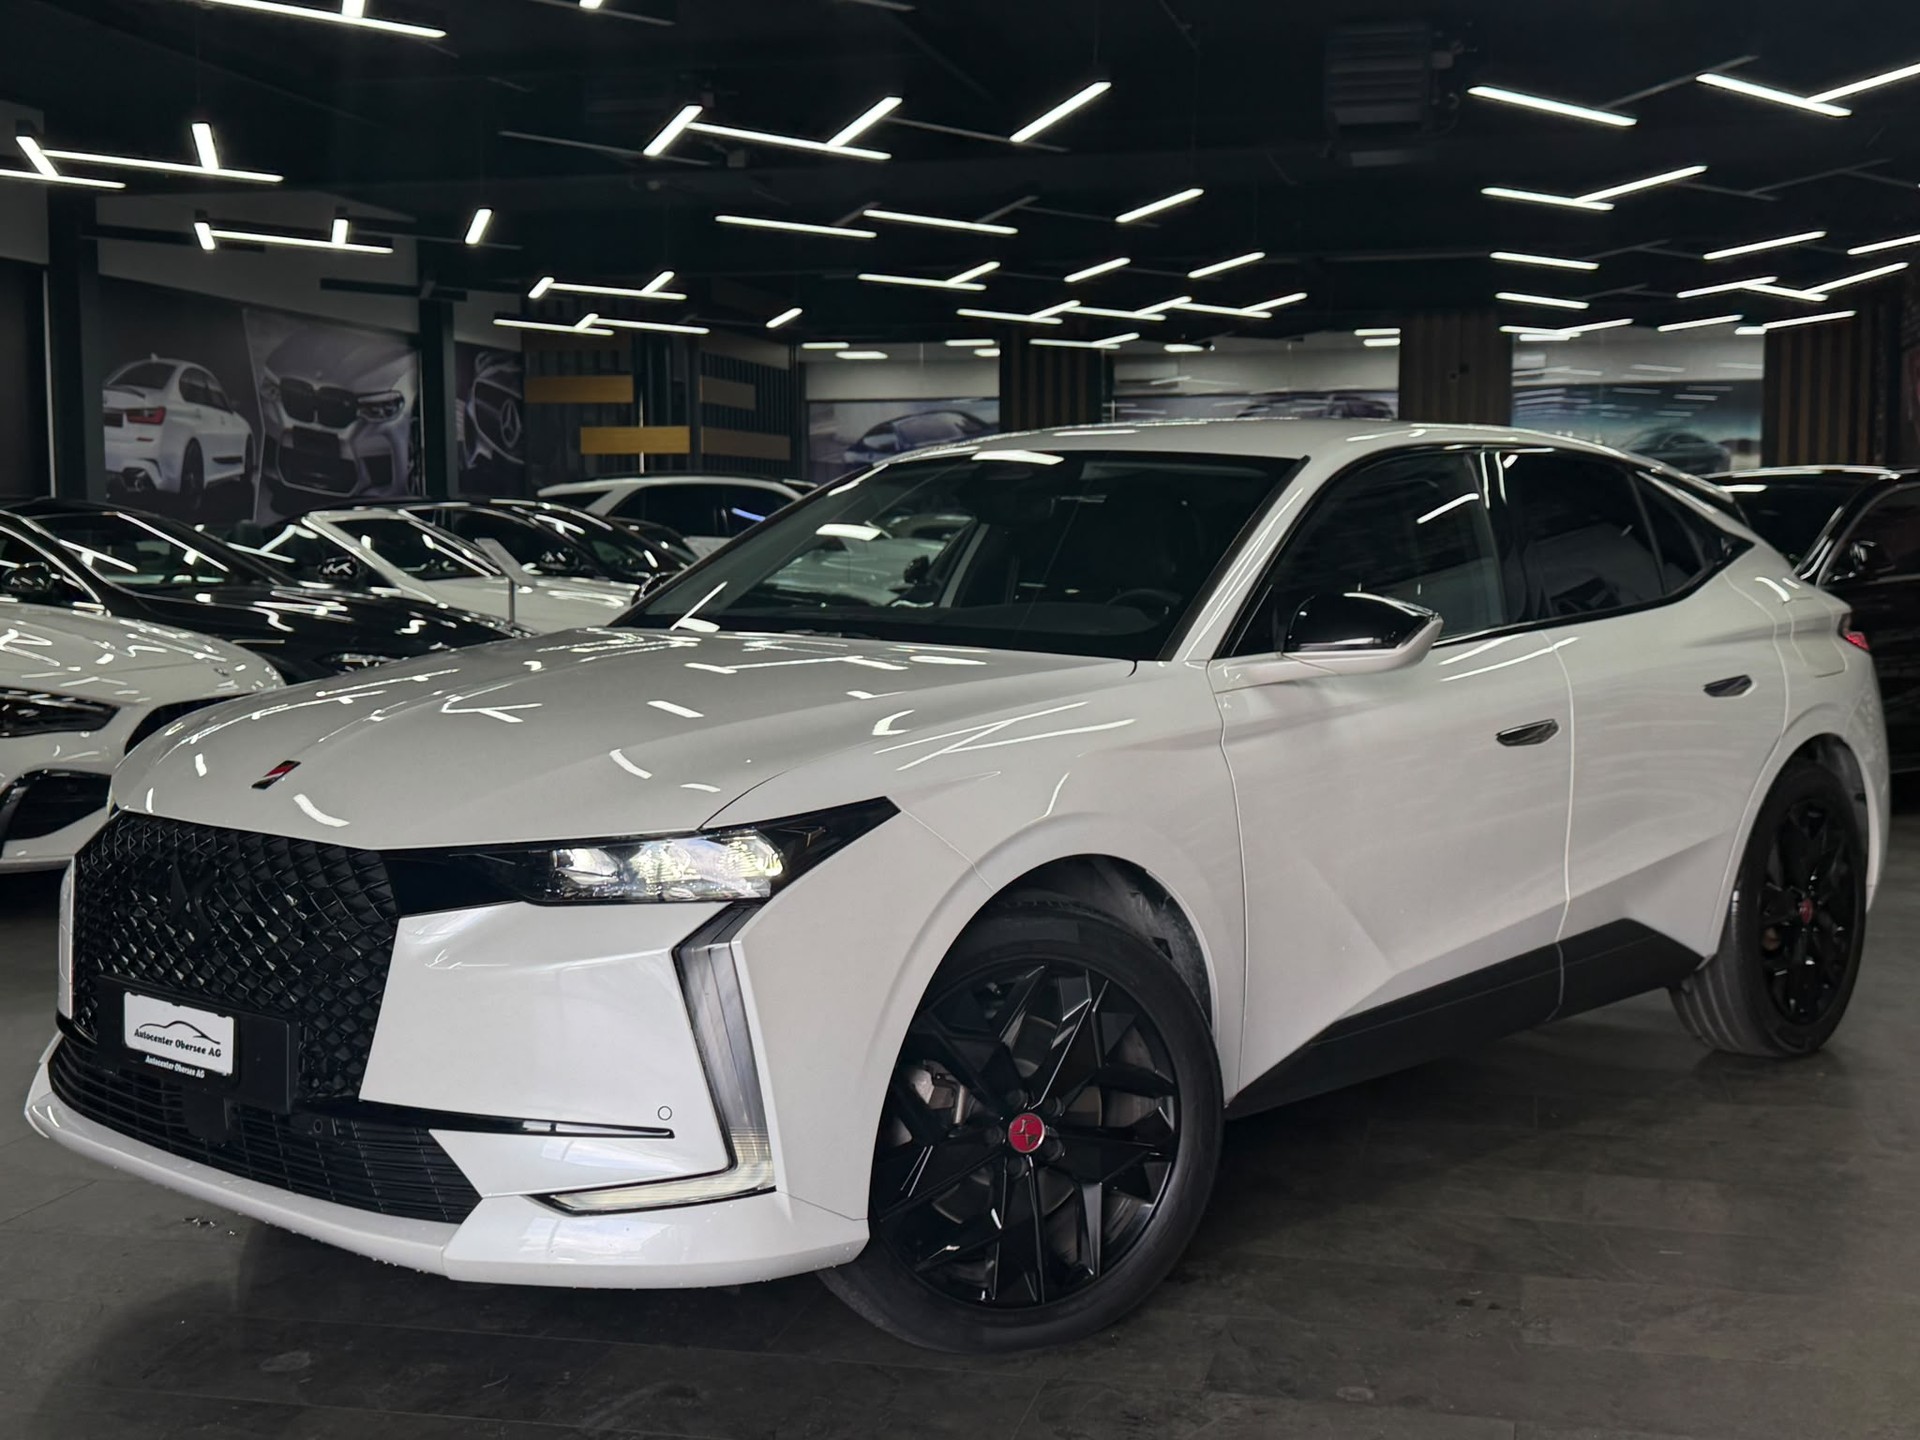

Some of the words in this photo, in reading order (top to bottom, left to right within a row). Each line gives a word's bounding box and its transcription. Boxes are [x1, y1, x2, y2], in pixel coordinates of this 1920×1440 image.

[134, 1028, 173, 1046] Autocenter
[175, 1039, 206, 1054] Obersee
[208, 1047, 221, 1057] AG
[145, 1055, 174, 1069] Autocenter
[175, 1062, 195, 1075] Obersee
[196, 1069, 205, 1078] AG
